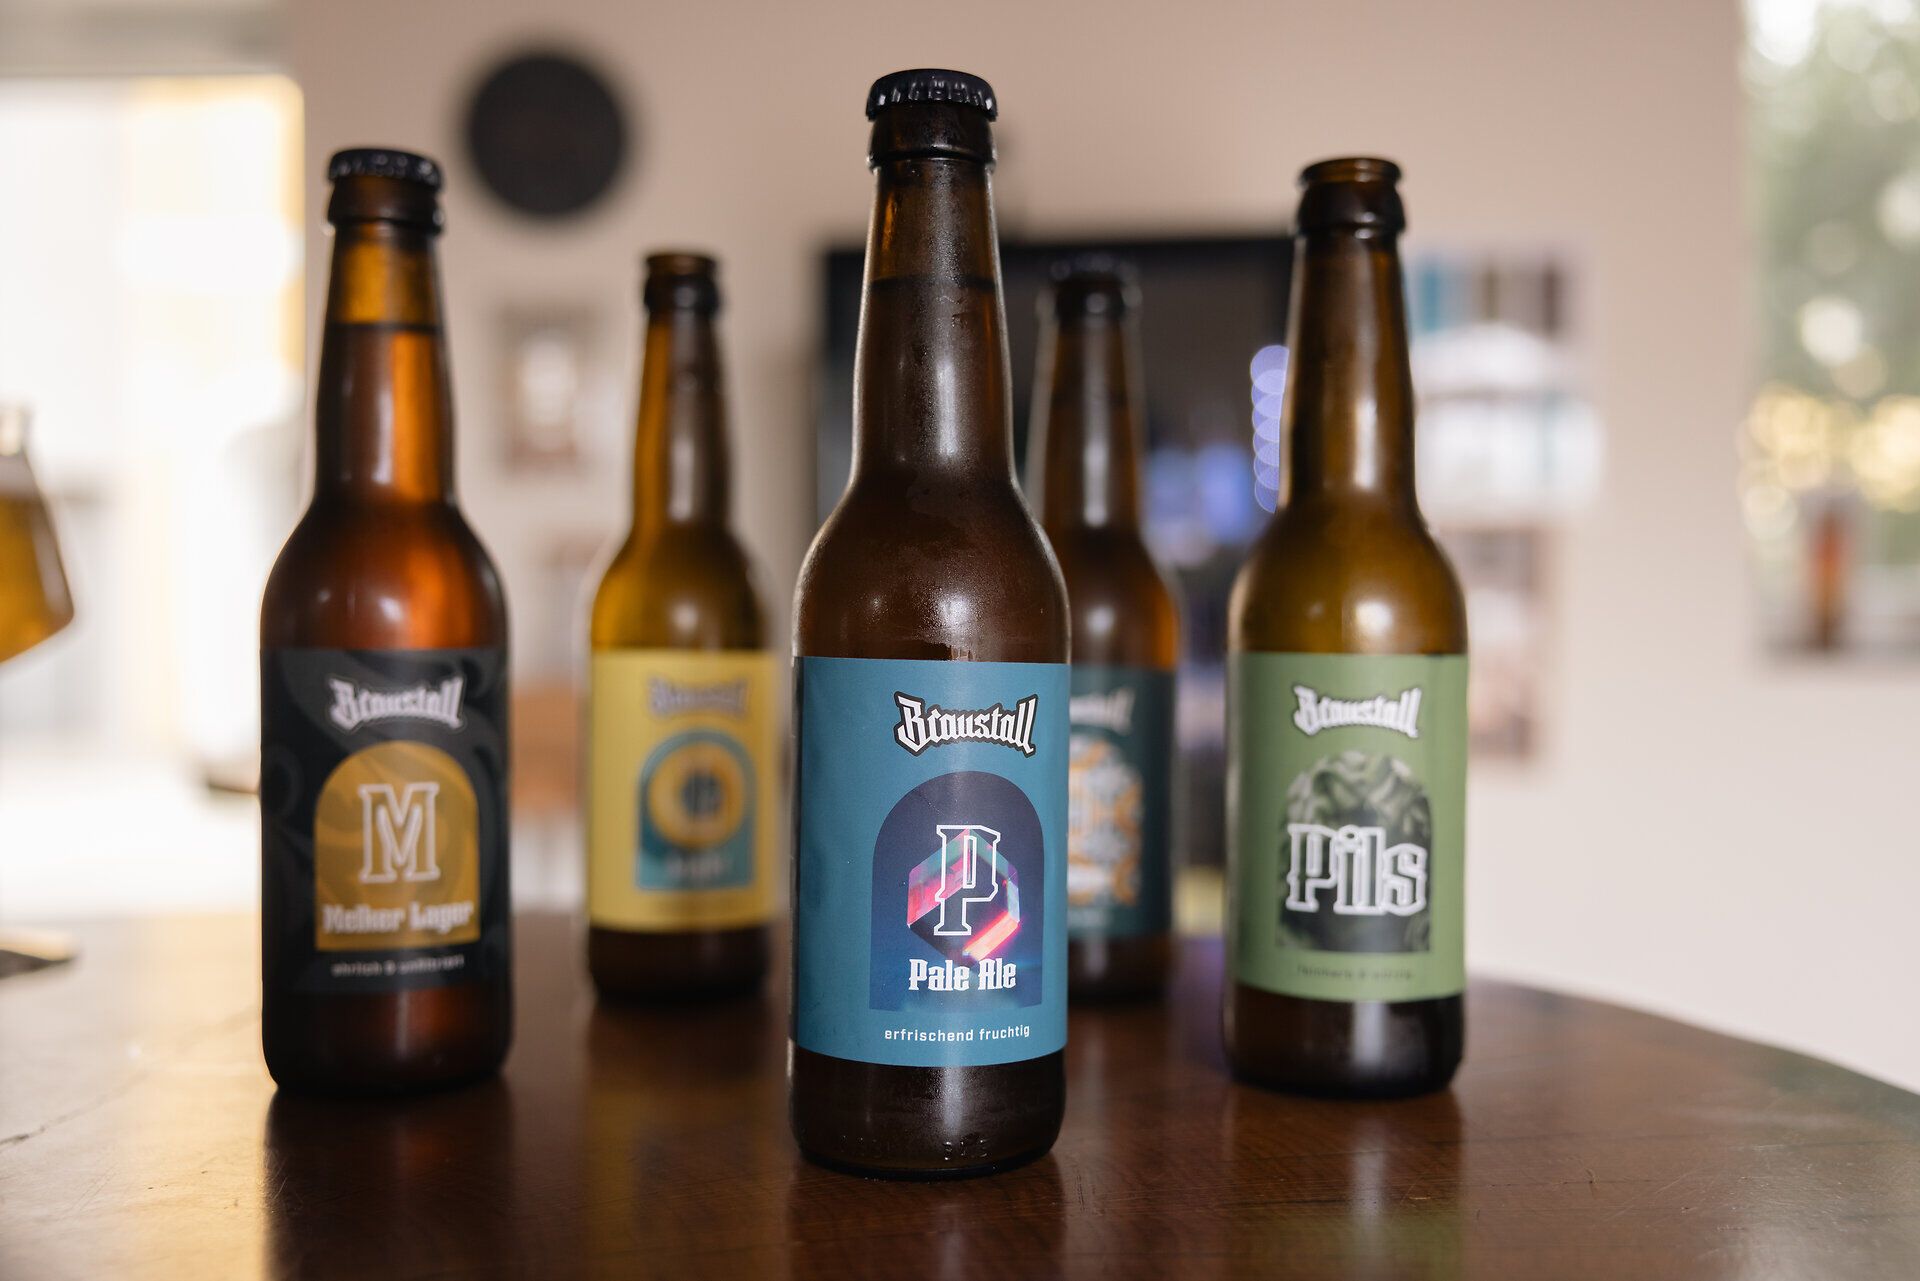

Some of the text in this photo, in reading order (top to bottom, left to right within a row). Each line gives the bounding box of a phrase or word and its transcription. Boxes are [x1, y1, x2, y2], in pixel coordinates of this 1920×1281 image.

[895, 692, 1038, 756] Braustall
[358, 781, 441, 884] M
[1285, 823, 1428, 917] Pils
[933, 824, 1002, 936] P
[908, 957, 1017, 991] Pale Ale
[884, 1024, 1030, 1042] erfrischend fruchtig
